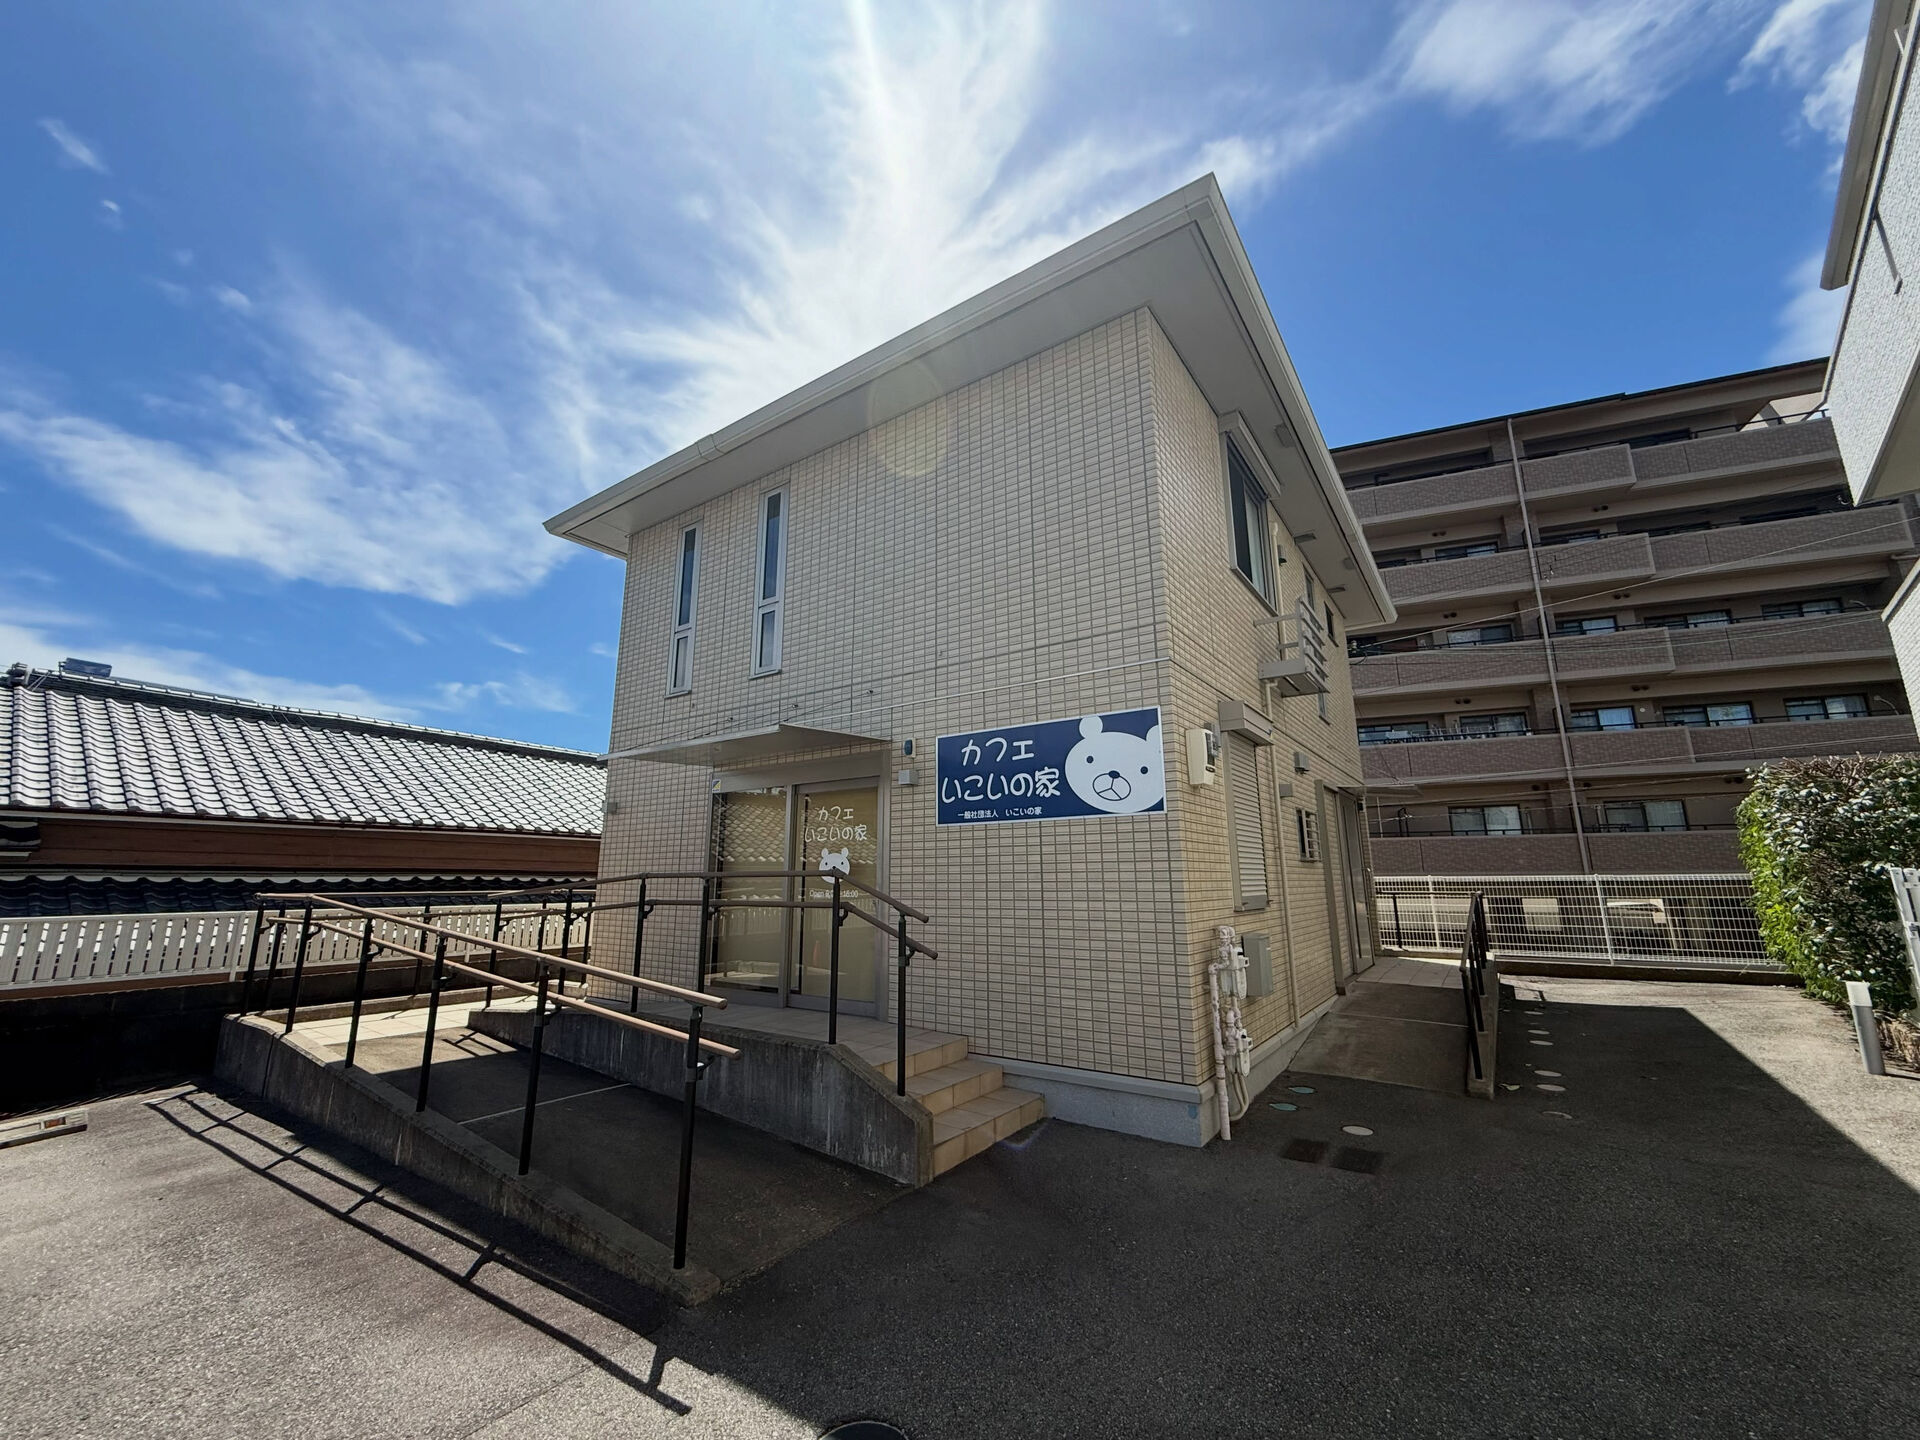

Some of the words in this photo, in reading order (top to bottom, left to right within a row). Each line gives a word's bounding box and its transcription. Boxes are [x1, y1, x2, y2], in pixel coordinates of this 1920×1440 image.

[961, 737, 1035, 766] カフェ
[941, 767, 1061, 804] いこいの家
[958, 809, 999, 819] 一般社団法人
[1005, 806, 1042, 816] いこいの家
[804, 824, 867, 842] いこいの家
